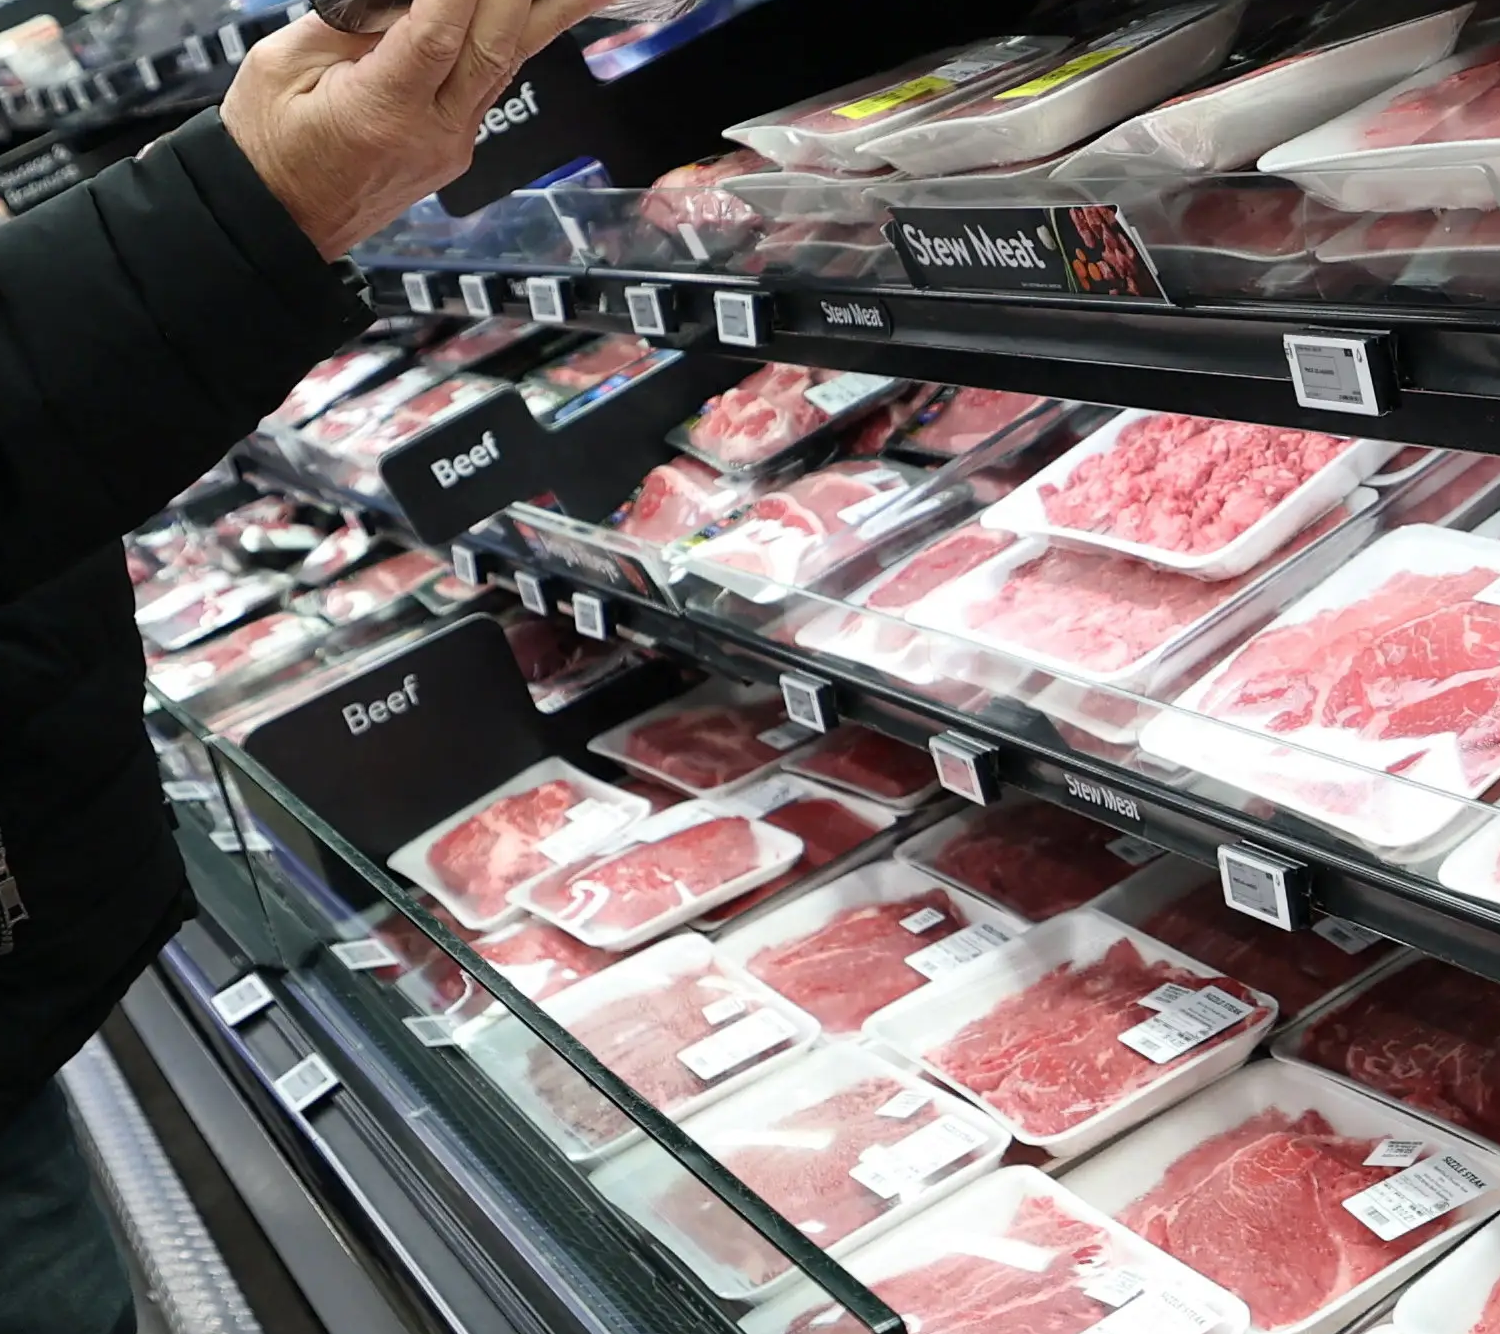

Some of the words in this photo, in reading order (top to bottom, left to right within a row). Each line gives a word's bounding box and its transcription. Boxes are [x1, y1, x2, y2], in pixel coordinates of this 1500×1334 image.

[902, 223, 972, 267] Stew
[963, 224, 1046, 269] Meat
[821, 300, 852, 324] Stew
[849, 303, 883, 327] Meat
[430, 430, 500, 489] Beef
[342, 673, 420, 736] Beef
[1064, 773, 1102, 806] Stew
[1100, 786, 1140, 821] Meat
[1443, 1156, 1467, 1178] SIZZLE
[1463, 1170, 1488, 1190] STEAK
